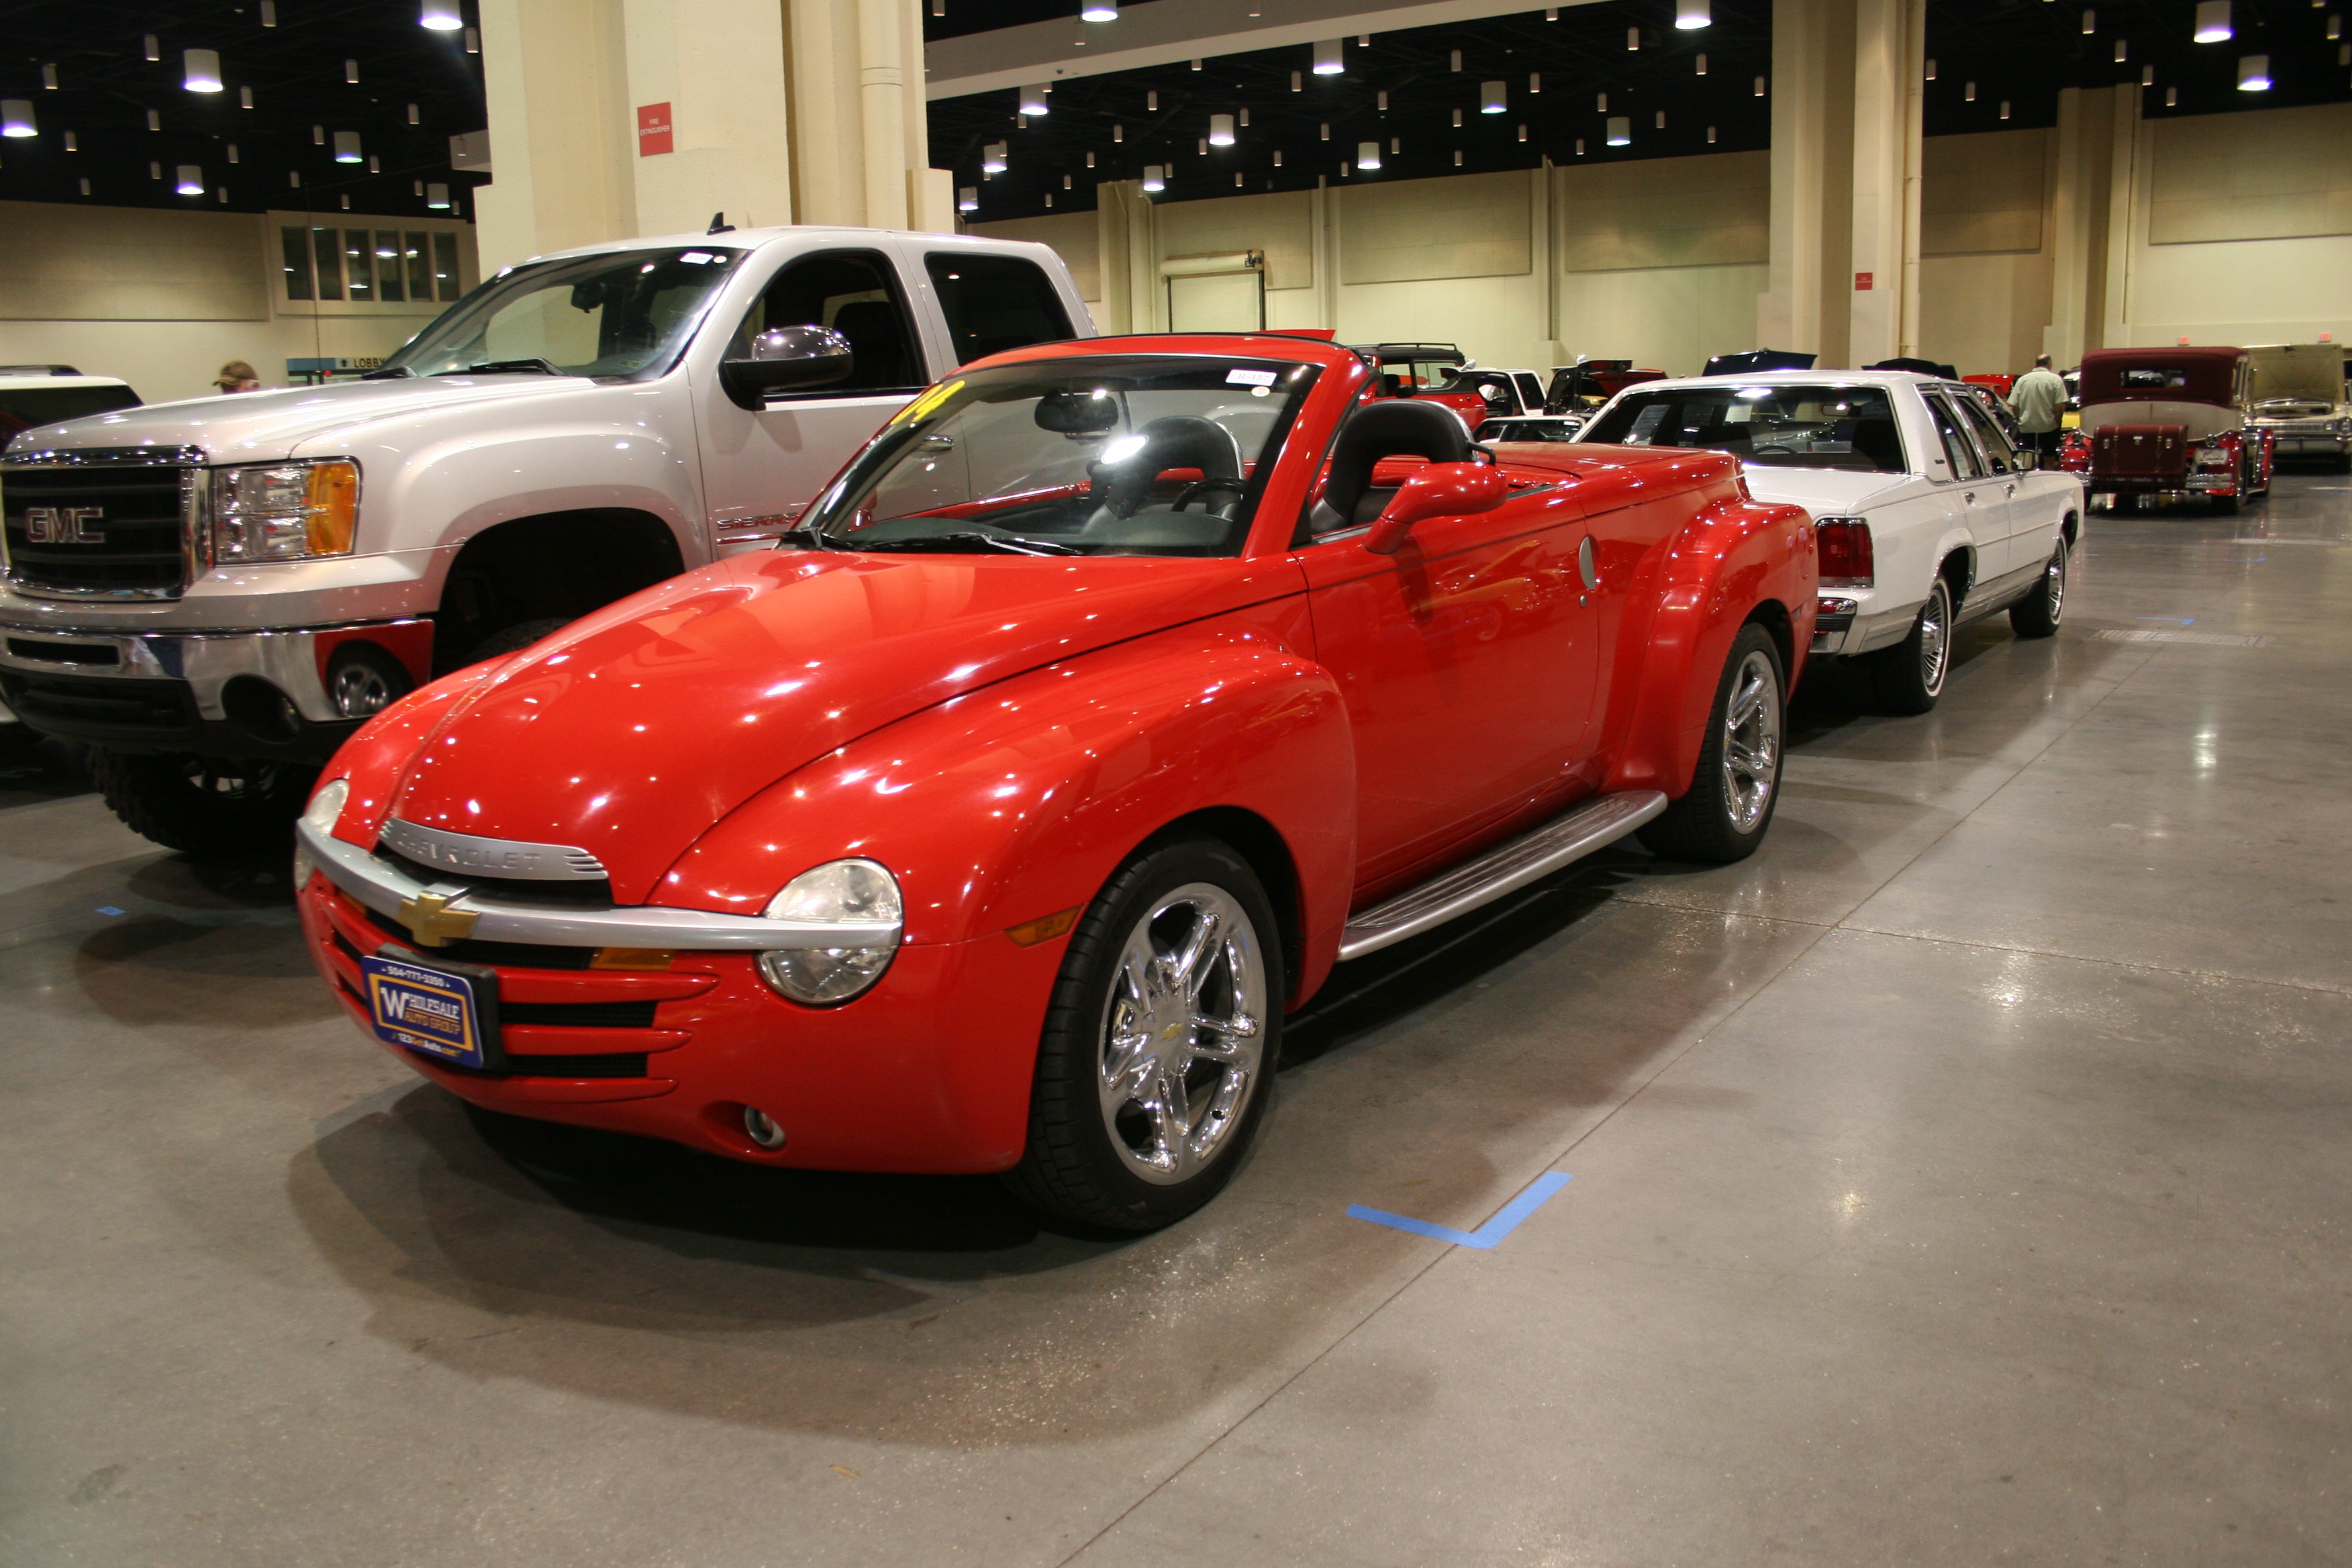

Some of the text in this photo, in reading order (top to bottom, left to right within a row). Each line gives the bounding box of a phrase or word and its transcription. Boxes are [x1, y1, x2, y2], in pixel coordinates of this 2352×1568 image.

[640, 125, 671, 136] EXTINGUISHER
[354, 358, 385, 368] LOBBY
[26, 507, 105, 543] GMC
[397, 831, 542, 871] CHEVROLET
[380, 987, 460, 1020] WHOLESALE
[403, 1011, 462, 1035] AUTO GROUP
